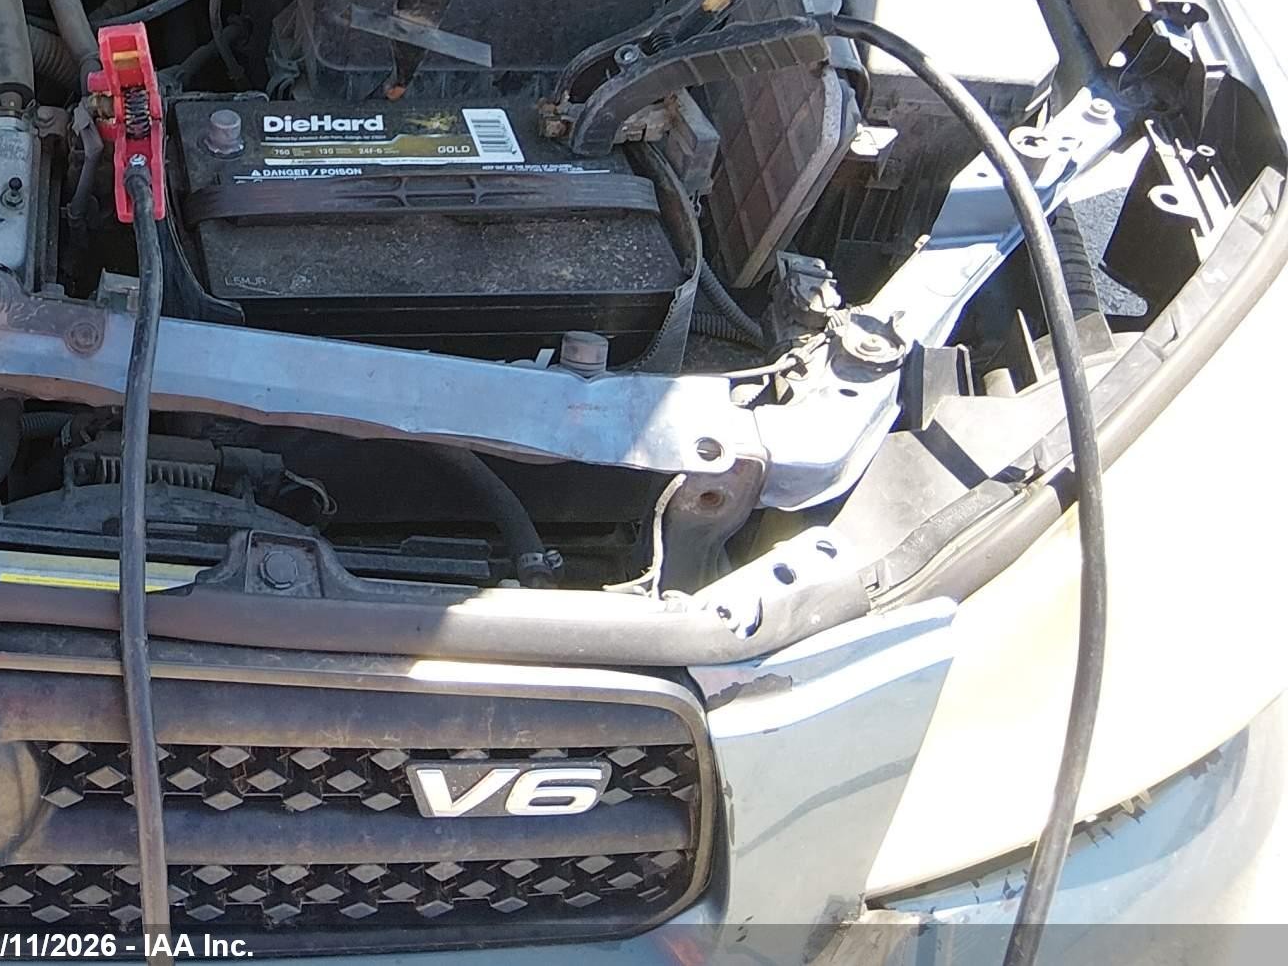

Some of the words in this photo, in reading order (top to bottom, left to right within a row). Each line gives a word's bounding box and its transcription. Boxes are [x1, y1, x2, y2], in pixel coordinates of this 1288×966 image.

[263, 115, 384, 132] DieHard
[437, 145, 470, 153] GOLD
[320, 167, 363, 176] POISON
[416, 768, 603, 817] V6
